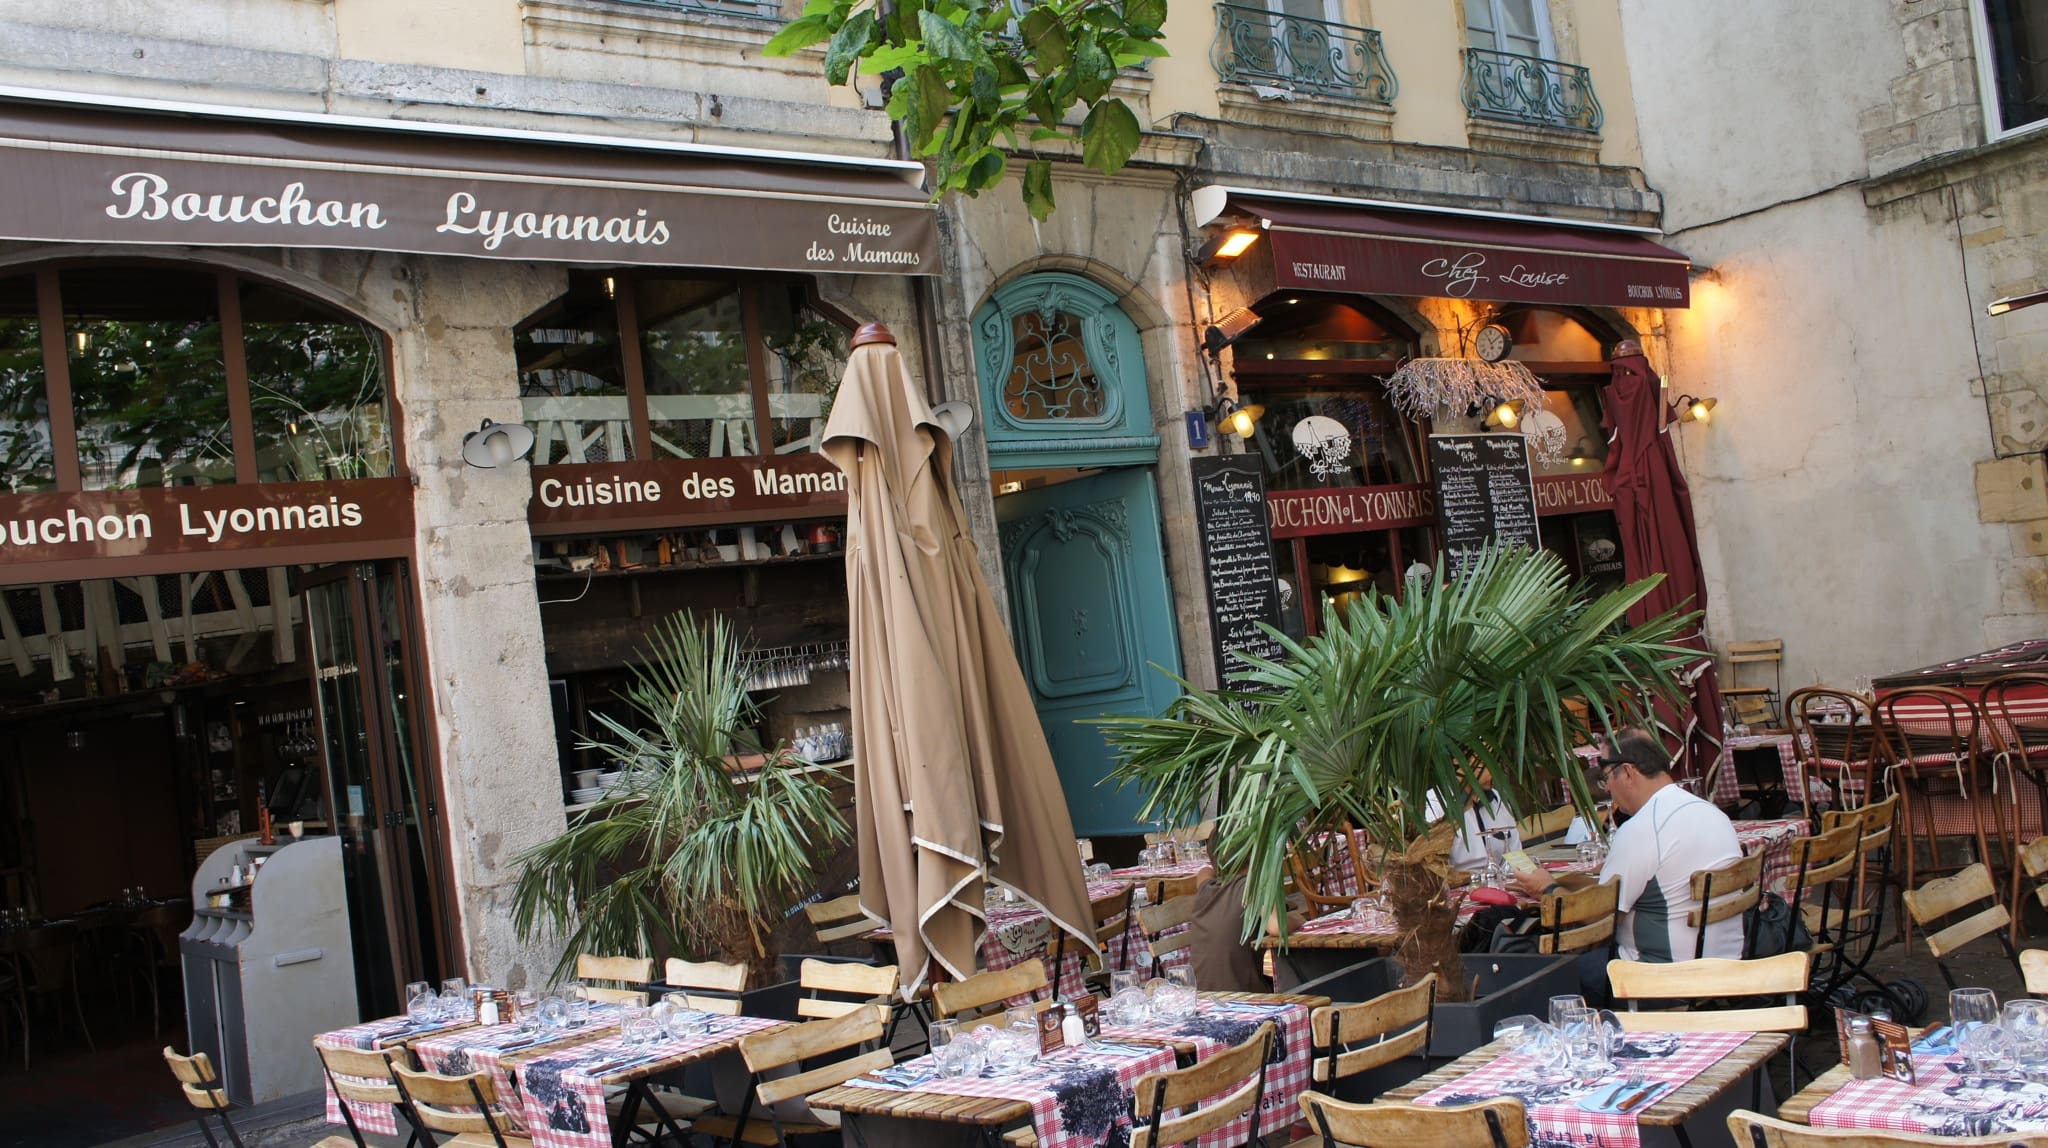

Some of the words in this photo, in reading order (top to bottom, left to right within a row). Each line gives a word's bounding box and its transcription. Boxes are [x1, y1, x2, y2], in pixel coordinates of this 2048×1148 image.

[106, 172, 387, 229] Bouchon
[436, 192, 671, 251] Lyonnais
[827, 214, 892, 236] Cuisine
[806, 241, 835, 261] des
[842, 242, 920, 265] Mamans
[1292, 262, 1346, 280] RESTAURANT
[1421, 252, 1490, 298] Chez
[1499, 264, 1569, 288] Louise
[1193, 419, 1202, 440] 1
[540, 475, 661, 508] Cuisine
[682, 471, 736, 499] des
[0, 509, 152, 546] uchon
[180, 497, 362, 543] Lyonnais
